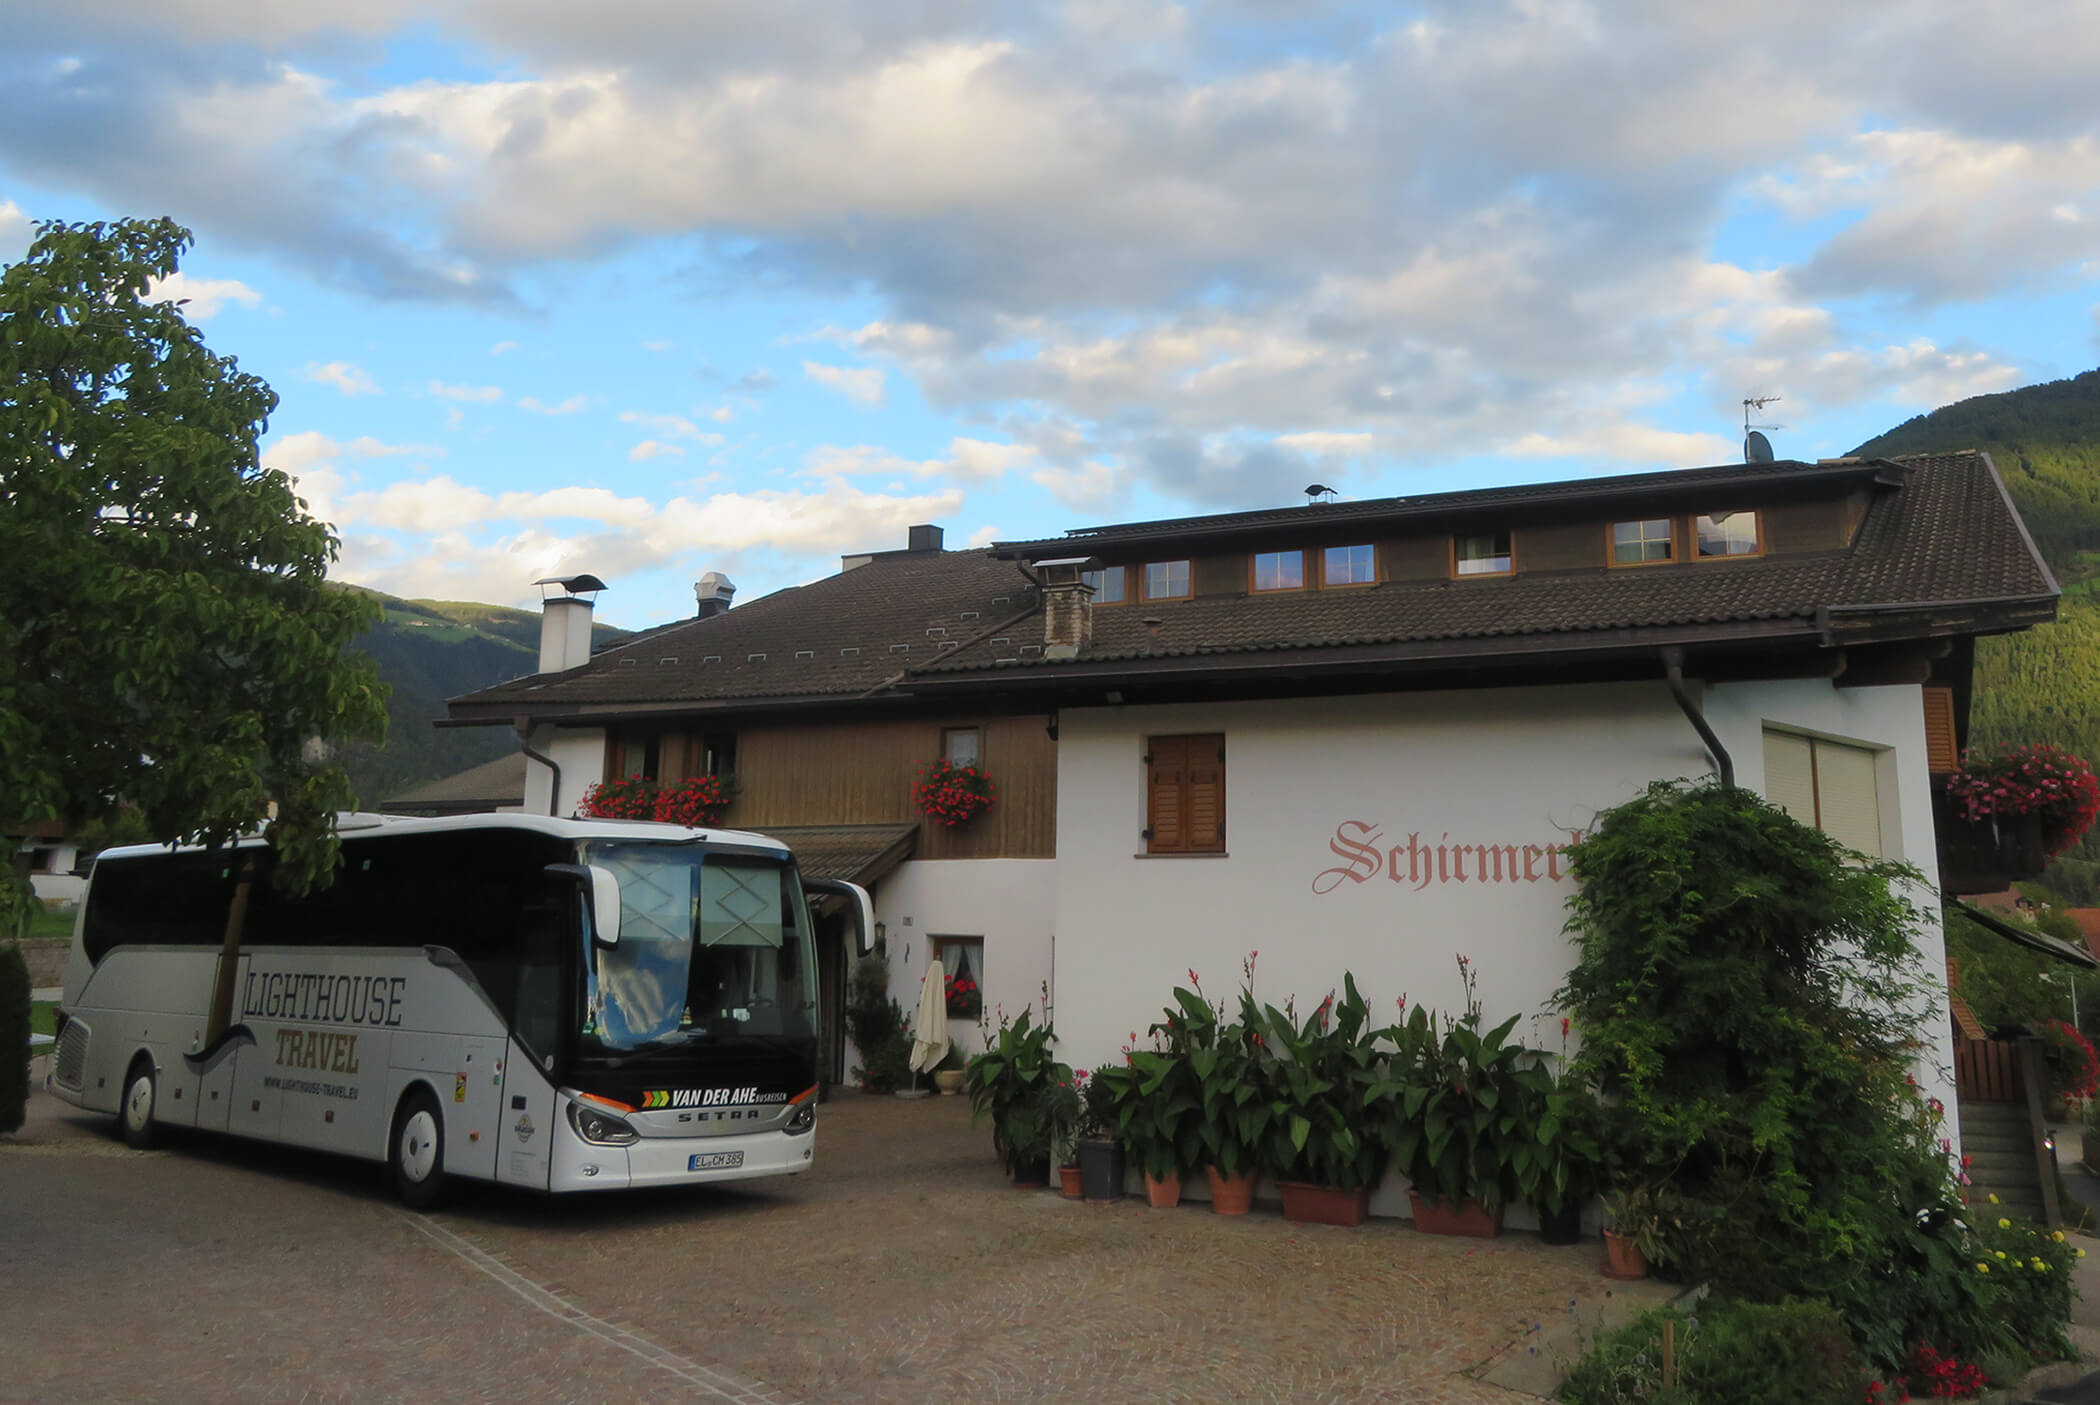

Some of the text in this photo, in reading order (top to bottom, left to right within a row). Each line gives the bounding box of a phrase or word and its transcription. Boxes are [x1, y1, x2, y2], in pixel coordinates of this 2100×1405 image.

[244, 972, 406, 1026] LIGHTHOUSE
[275, 1028, 359, 1074] TRAVEL
[672, 1089, 702, 1106] VAN
[702, 1088, 730, 1105] DER
[729, 1087, 758, 1105] AHE
[678, 1109, 759, 1122] SETRA
